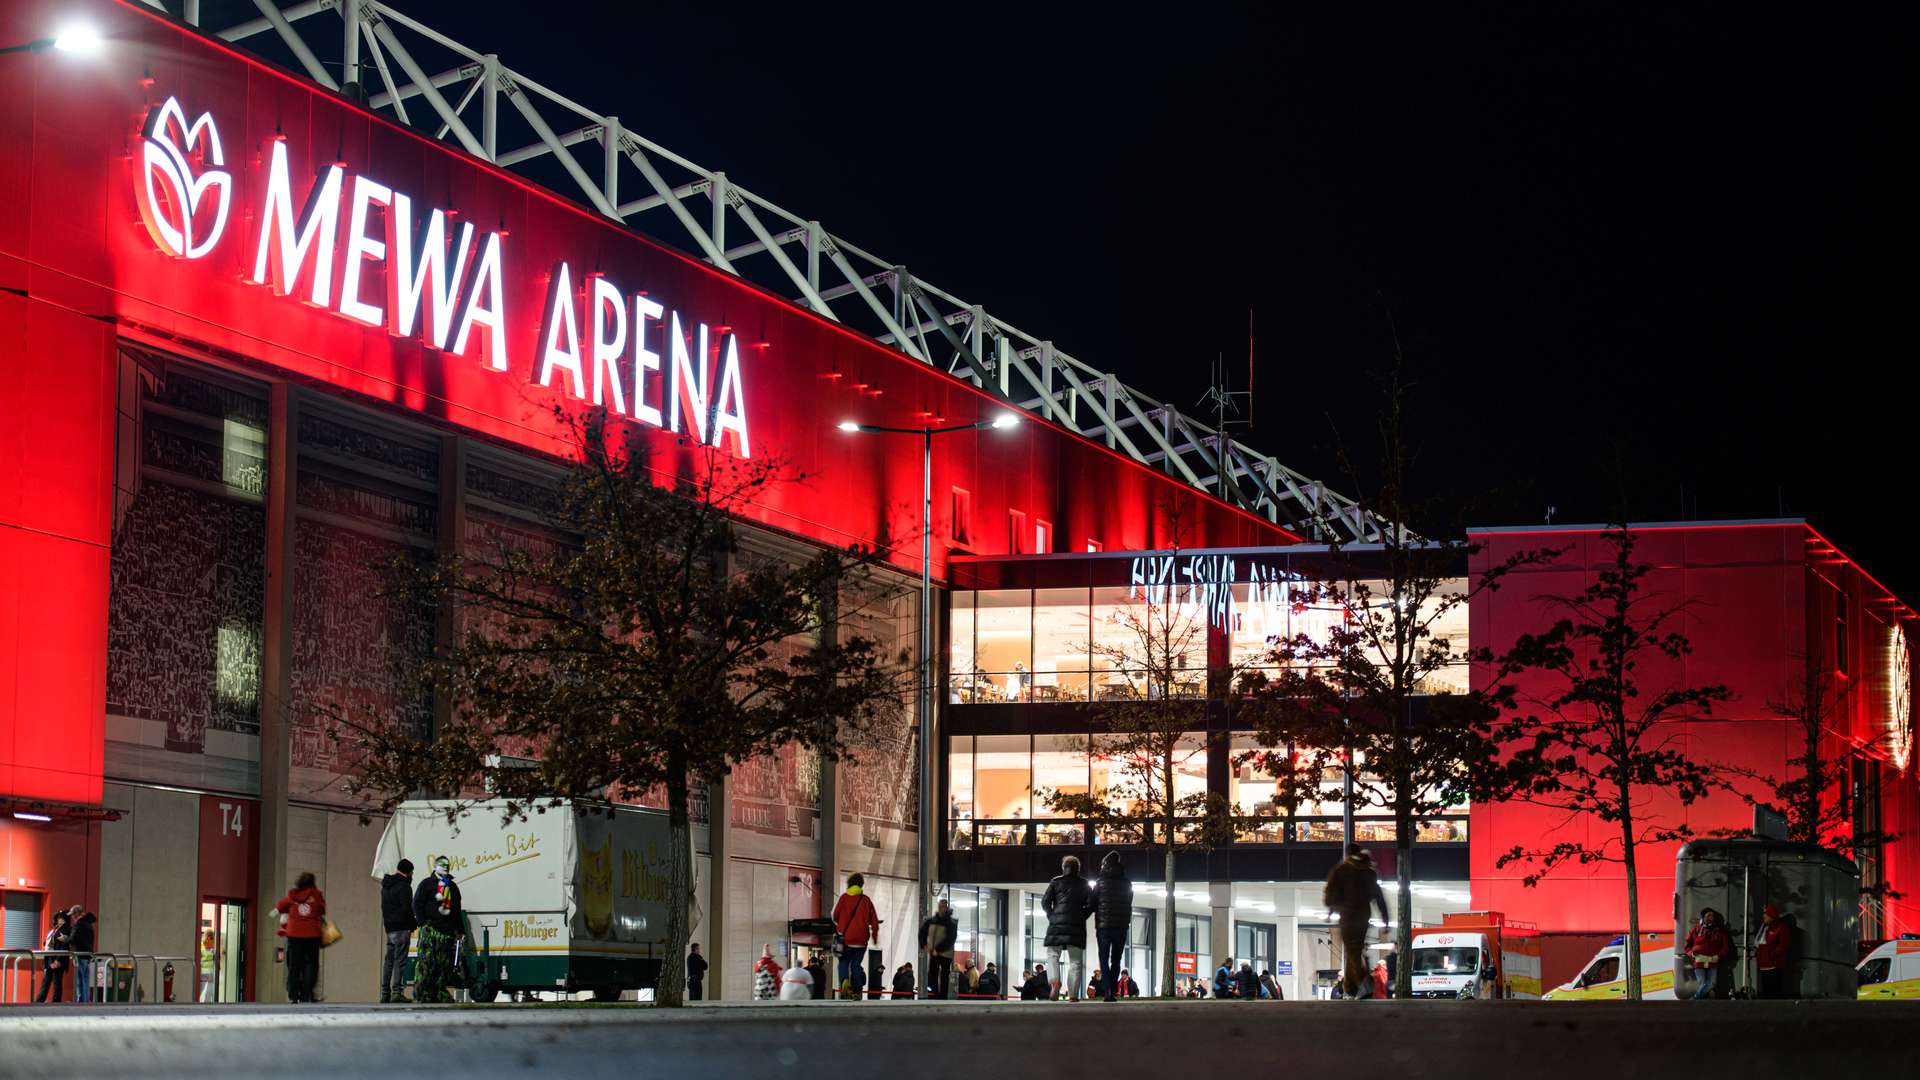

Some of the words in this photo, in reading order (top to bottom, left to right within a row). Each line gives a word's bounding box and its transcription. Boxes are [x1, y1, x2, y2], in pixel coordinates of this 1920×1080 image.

[251, 140, 508, 372] MEWA
[537, 261, 750, 458] ARENA
[219, 802, 243, 837] T4
[426, 853, 468, 874] Btte
[475, 850, 502, 865] ein
[506, 832, 541, 856] Bit
[799, 873, 813, 898] T3
[503, 919, 559, 941] Bitburger
